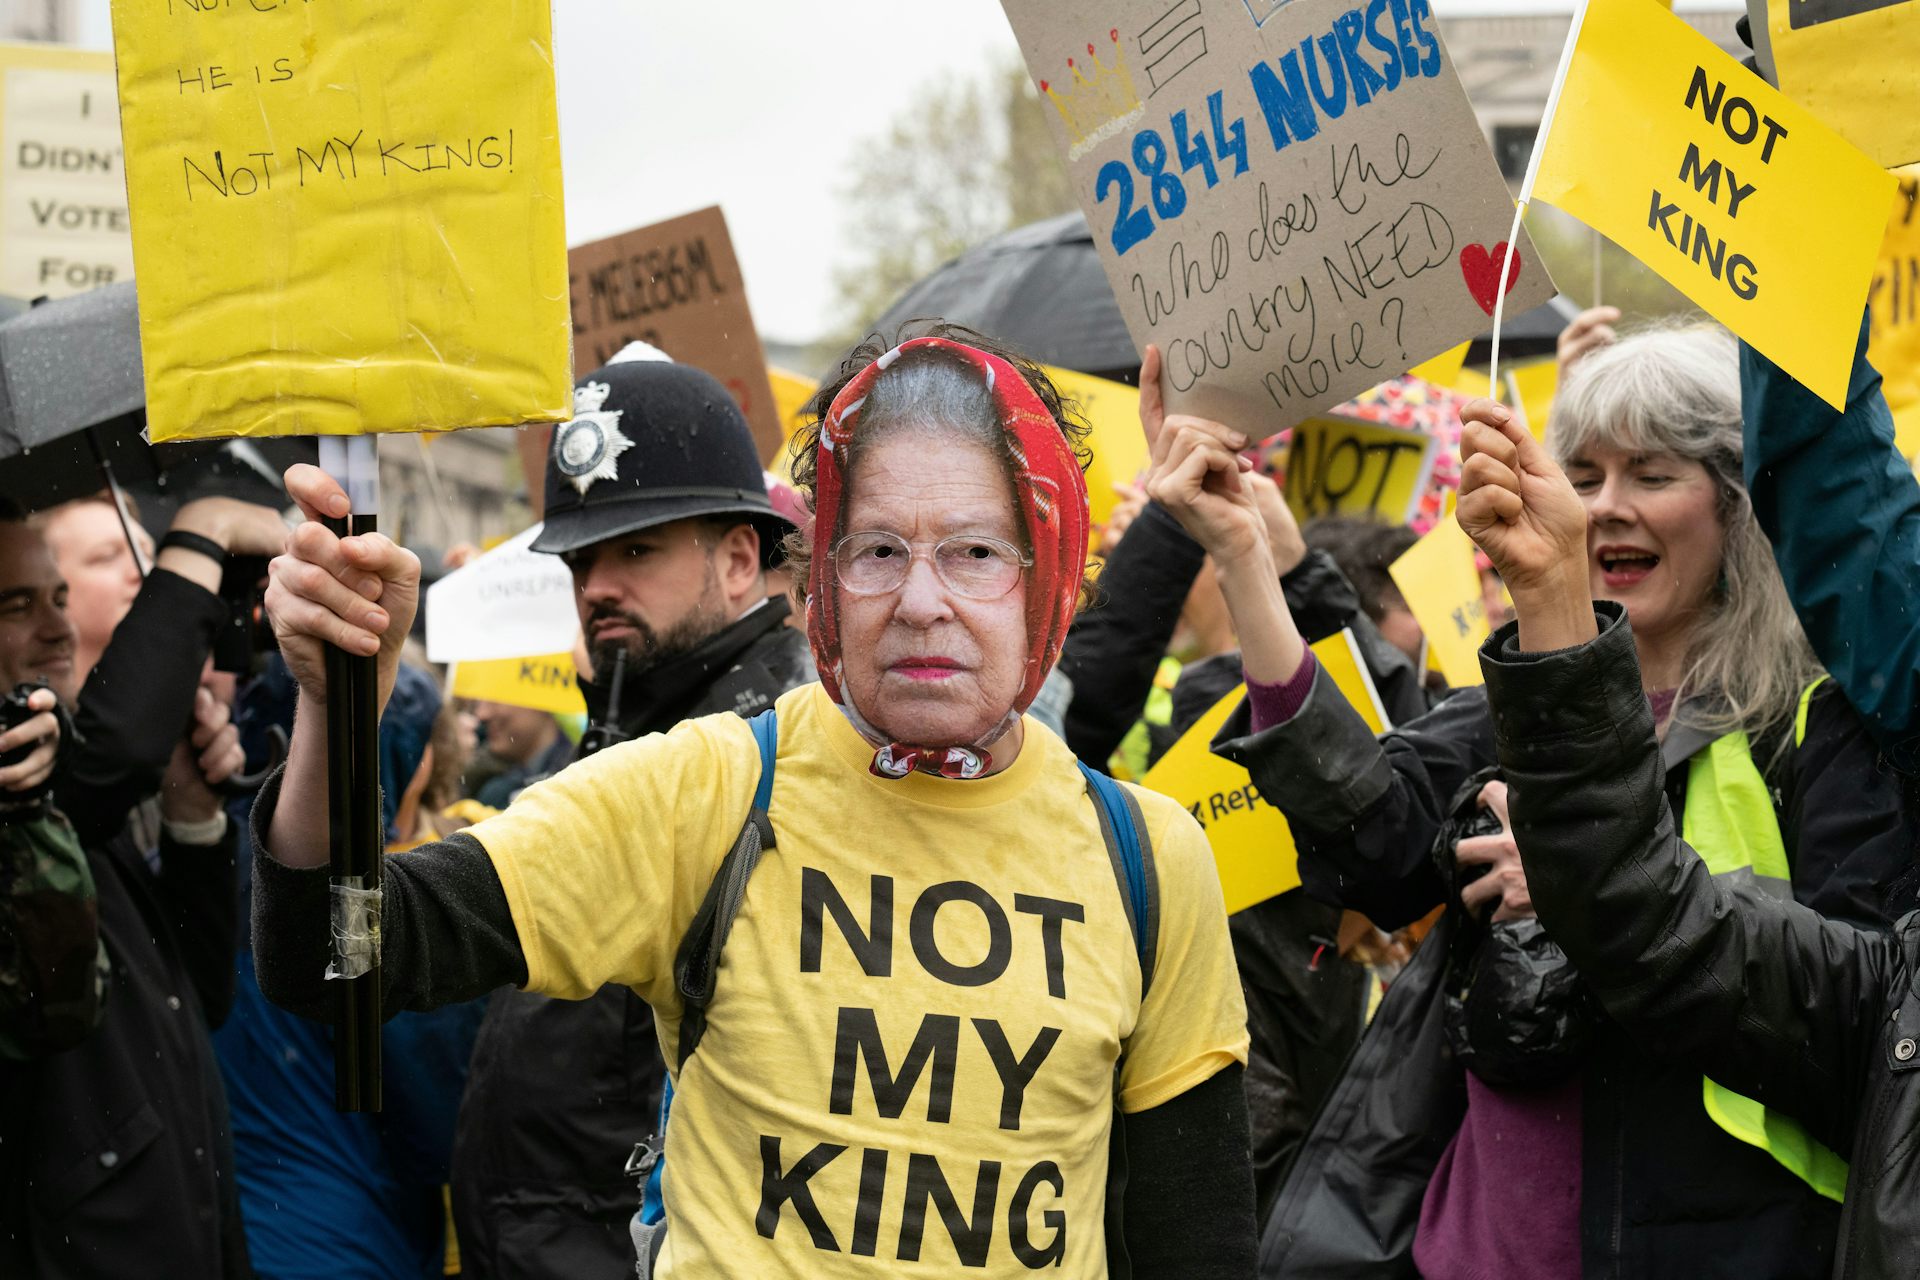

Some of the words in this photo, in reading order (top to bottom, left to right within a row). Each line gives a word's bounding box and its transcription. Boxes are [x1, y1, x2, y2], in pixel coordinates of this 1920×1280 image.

[177, 66, 233, 94] HE
[255, 58, 293, 83] IS
[1096, 89, 1250, 256] 2844
[1248, 0, 1442, 152] NURSES
[1684, 65, 1789, 165] NOT
[183, 150, 274, 200] NOT
[297, 130, 363, 186] MY
[378, 129, 515, 175] KING!
[1249, 181, 1318, 262] does
[1331, 133, 1443, 215] the
[1678, 142, 1757, 219] MY
[1166, 276, 1315, 392] country
[1323, 202, 1455, 302] NEED
[1647, 189, 1759, 302] KING
[1284, 426, 1423, 520] NOT
[518, 659, 577, 688] KIN
[1208, 782, 1262, 821] Rep
[800, 866, 1085, 1000] NOT
[829, 1006, 1063, 1131] MY
[755, 1134, 1067, 1270] KING
